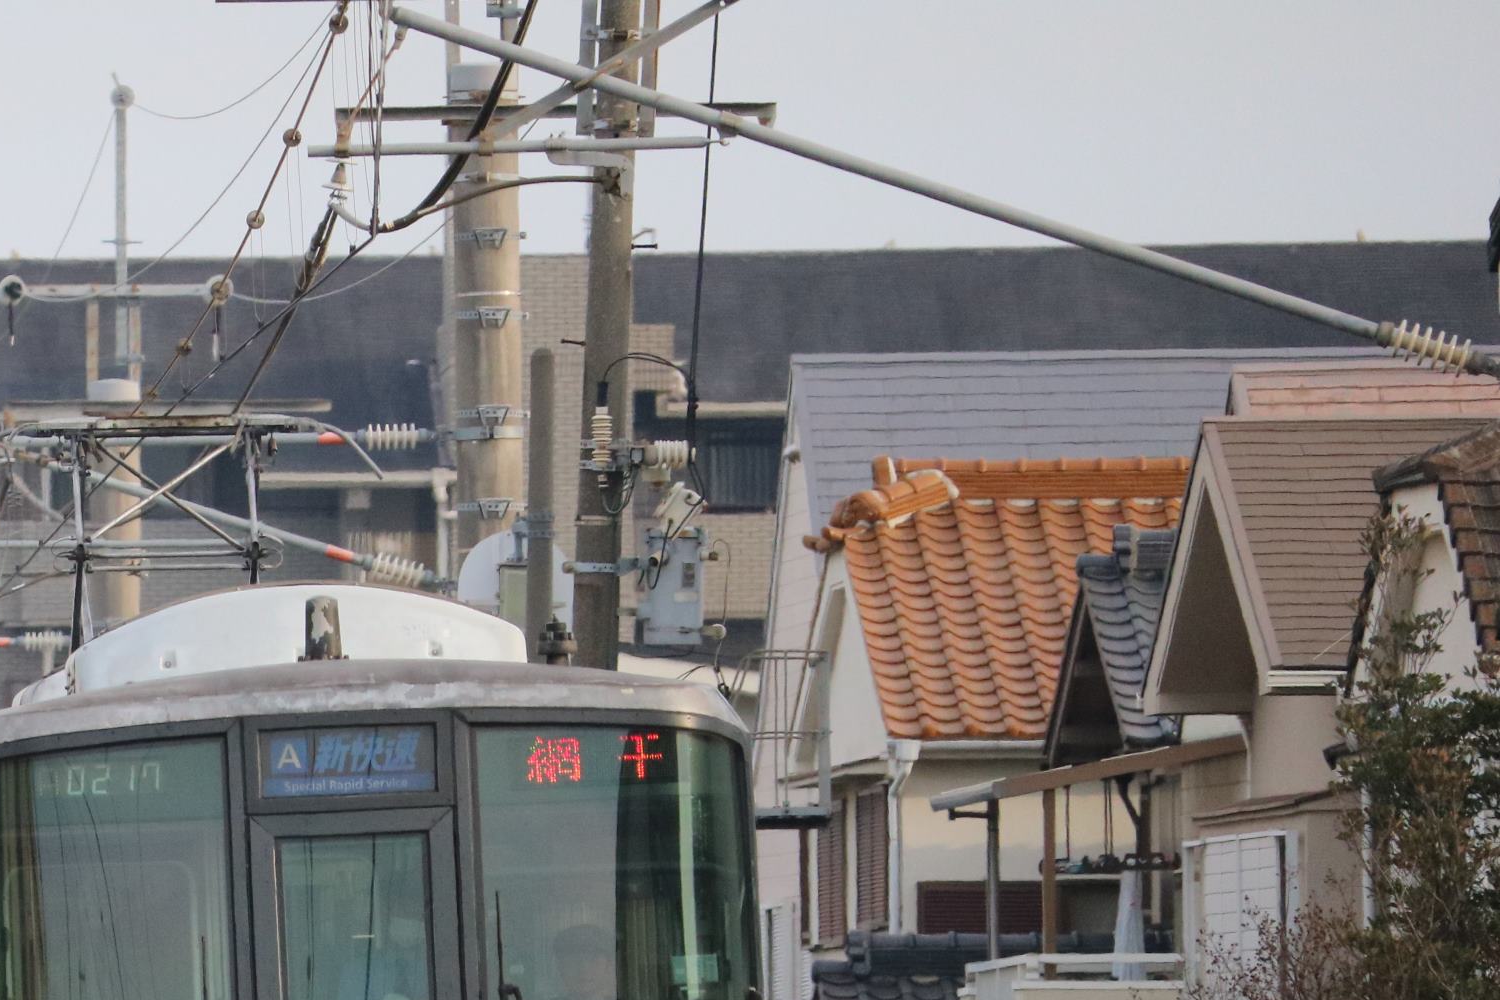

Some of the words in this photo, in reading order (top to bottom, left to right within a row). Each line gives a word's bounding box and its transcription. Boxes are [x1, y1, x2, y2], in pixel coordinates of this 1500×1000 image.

[277, 743, 302, 769] A
[314, 729, 421, 773] 新快速
[526, 732, 663, 783] 網干
[284, 779, 327, 793] Special
[329, 777, 363, 791] Rapid
[367, 777, 408, 790] Service
